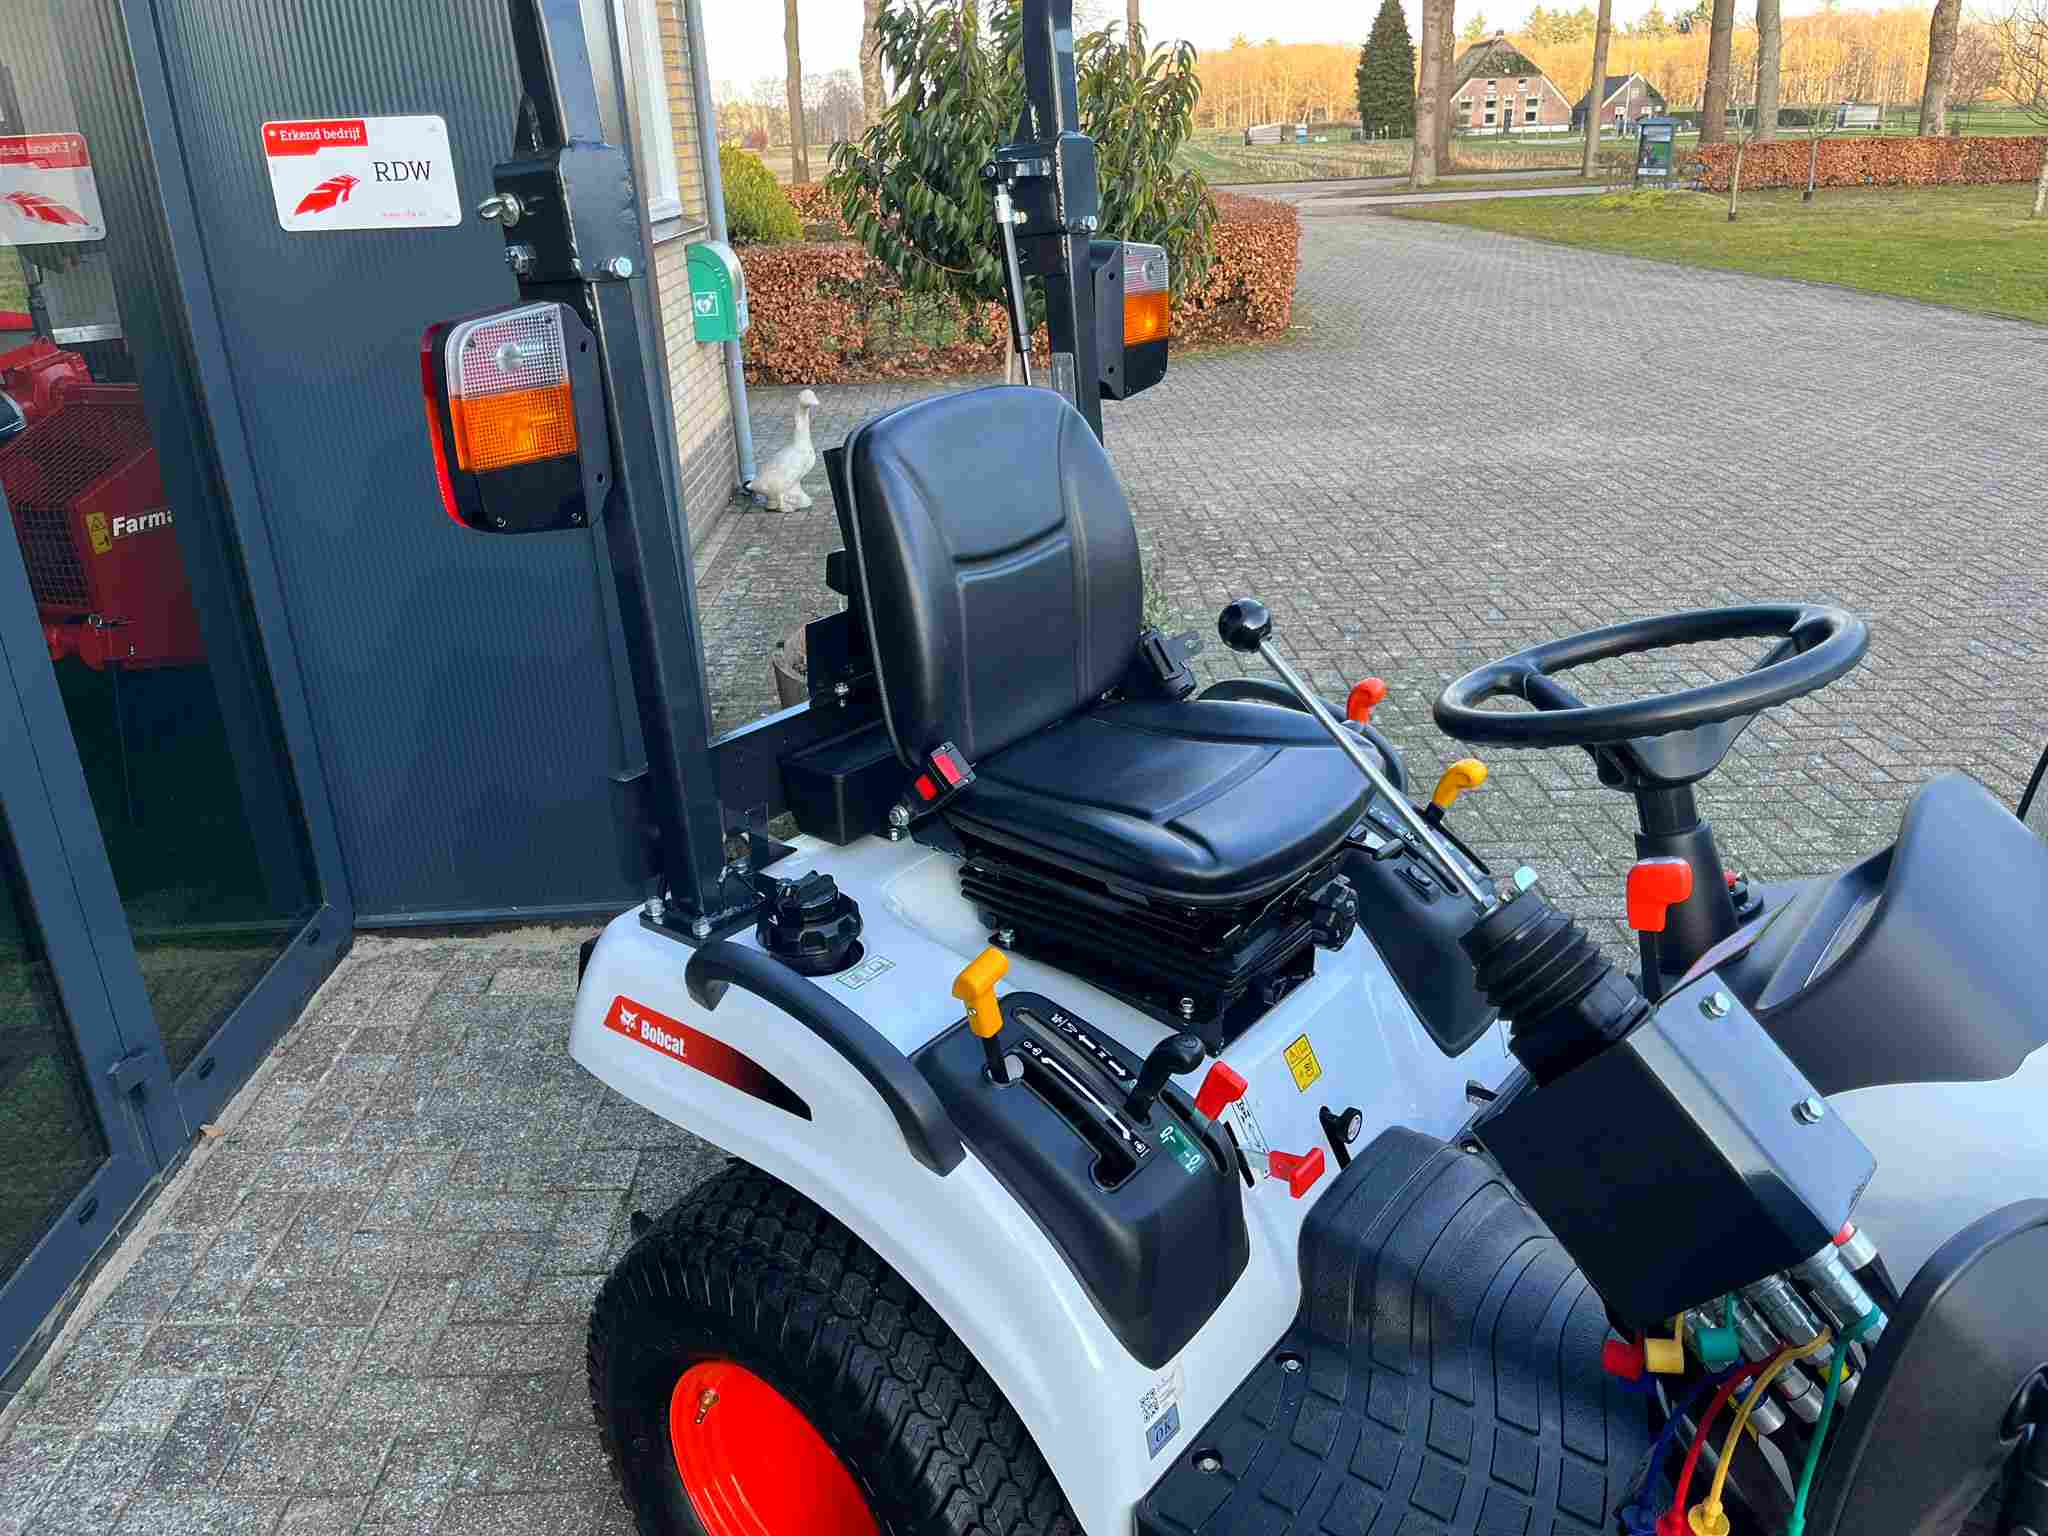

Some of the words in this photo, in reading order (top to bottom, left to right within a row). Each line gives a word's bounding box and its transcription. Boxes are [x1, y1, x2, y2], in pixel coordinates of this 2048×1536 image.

[279, 128, 322, 142] Erkend
[323, 127, 361, 141] bedrijf
[373, 161, 431, 182] RDW
[639, 1019, 685, 1056] Bobcat
